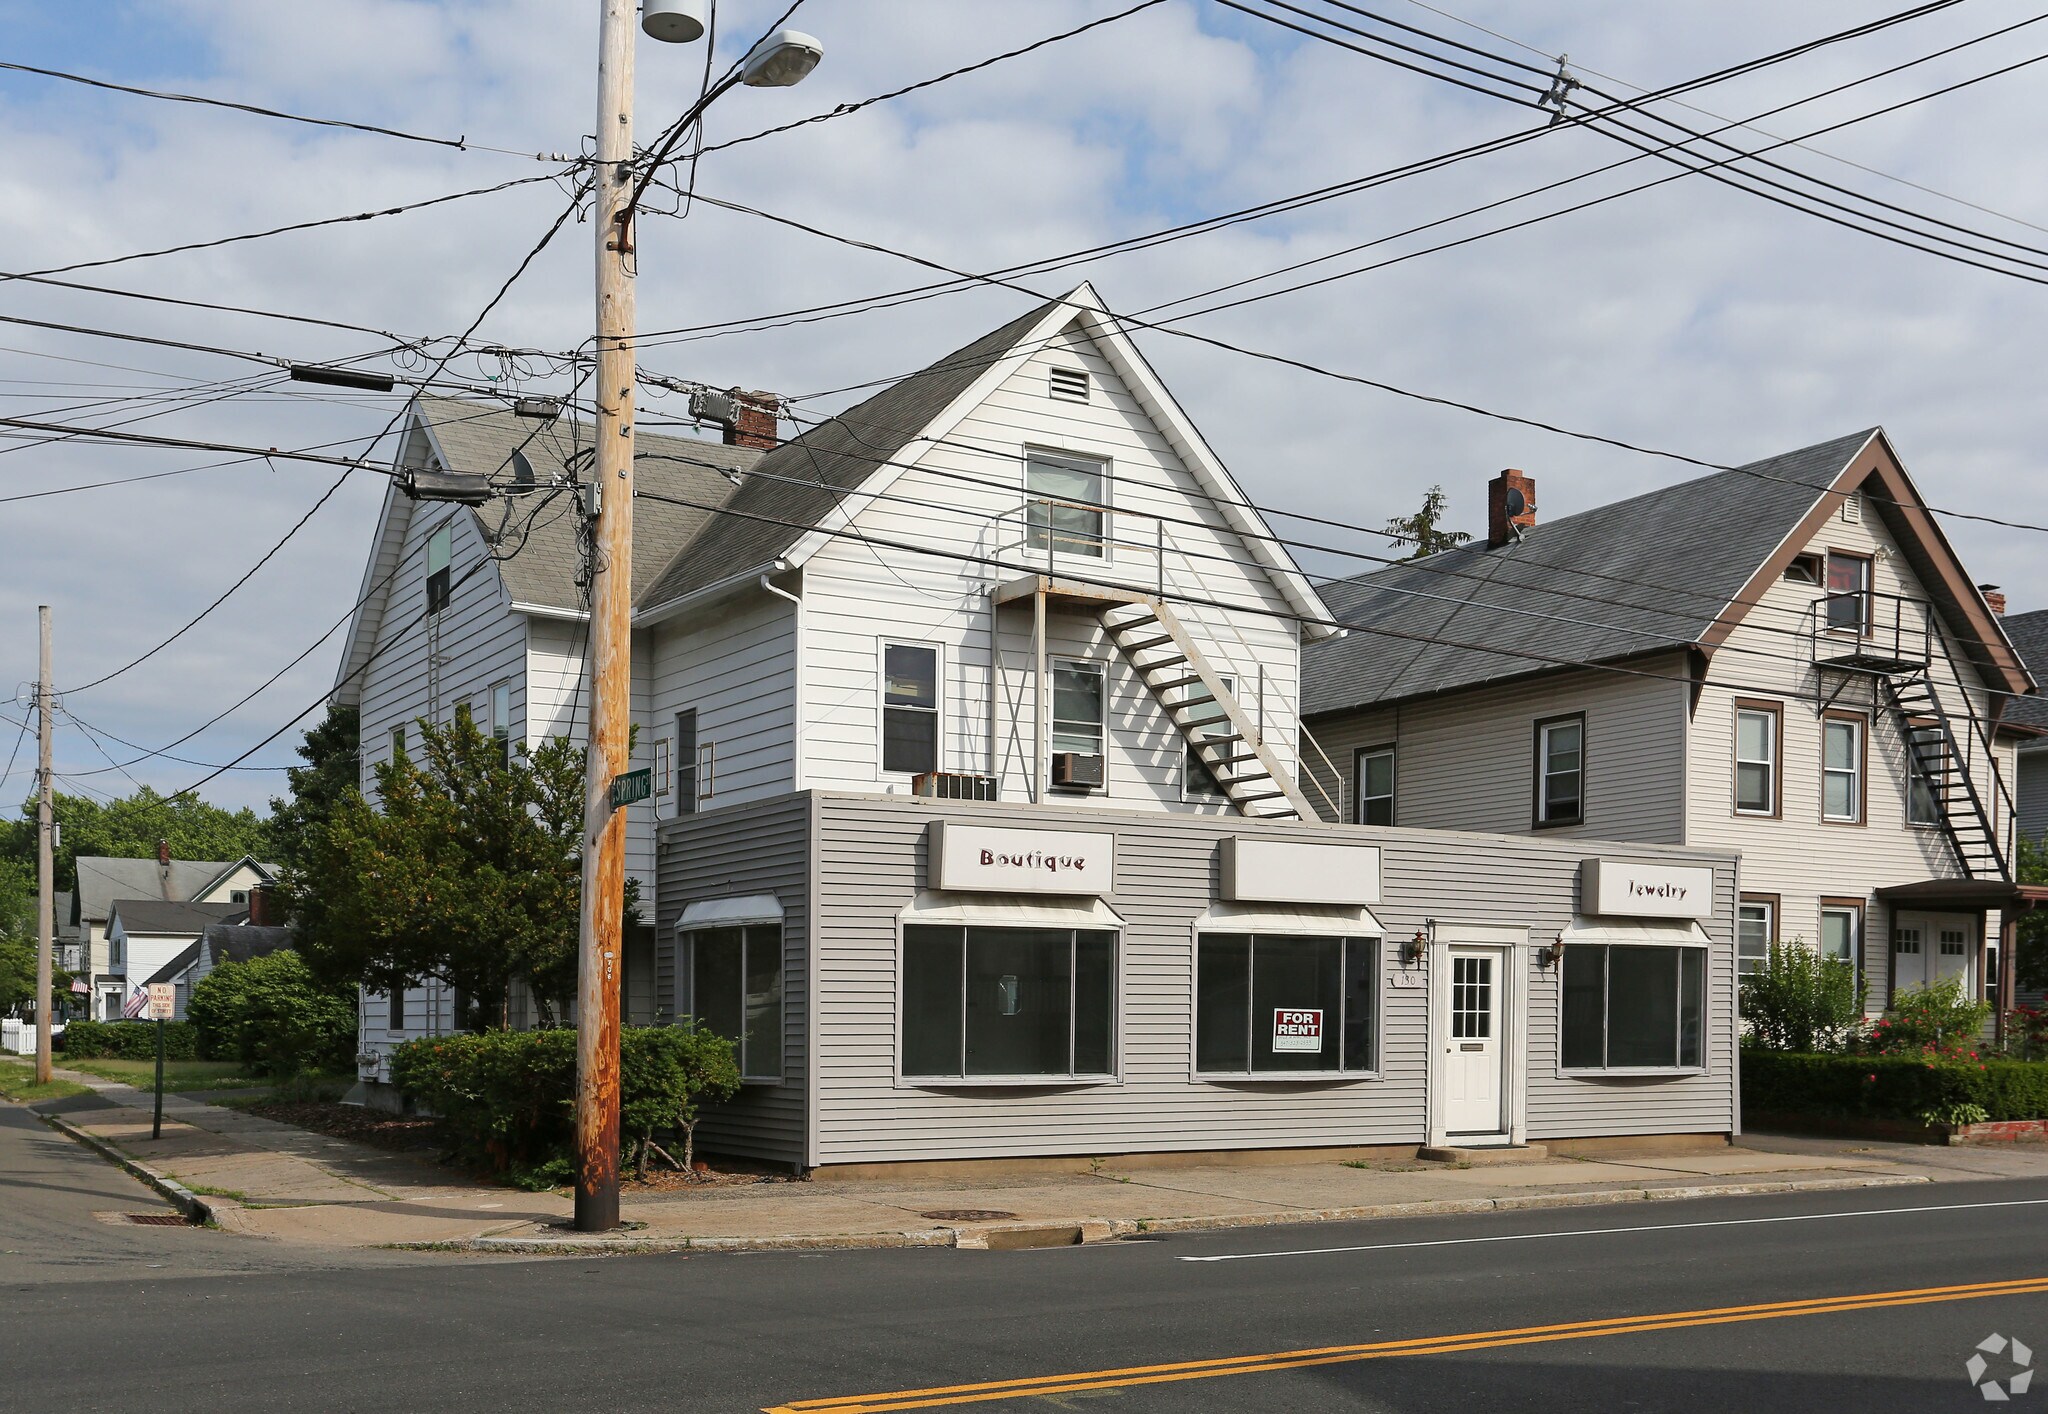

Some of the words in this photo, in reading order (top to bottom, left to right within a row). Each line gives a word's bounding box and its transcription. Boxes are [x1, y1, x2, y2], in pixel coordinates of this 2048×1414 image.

[616, 775, 647, 802] SPRING
[979, 848, 1085, 872] Boutique
[1628, 880, 1687, 901] Jewelry
[1401, 974, 1416, 986] 130
[150, 994, 173, 1002] PARKING
[1283, 1012, 1314, 1024] FOR
[1277, 1024, 1319, 1035] RENT
